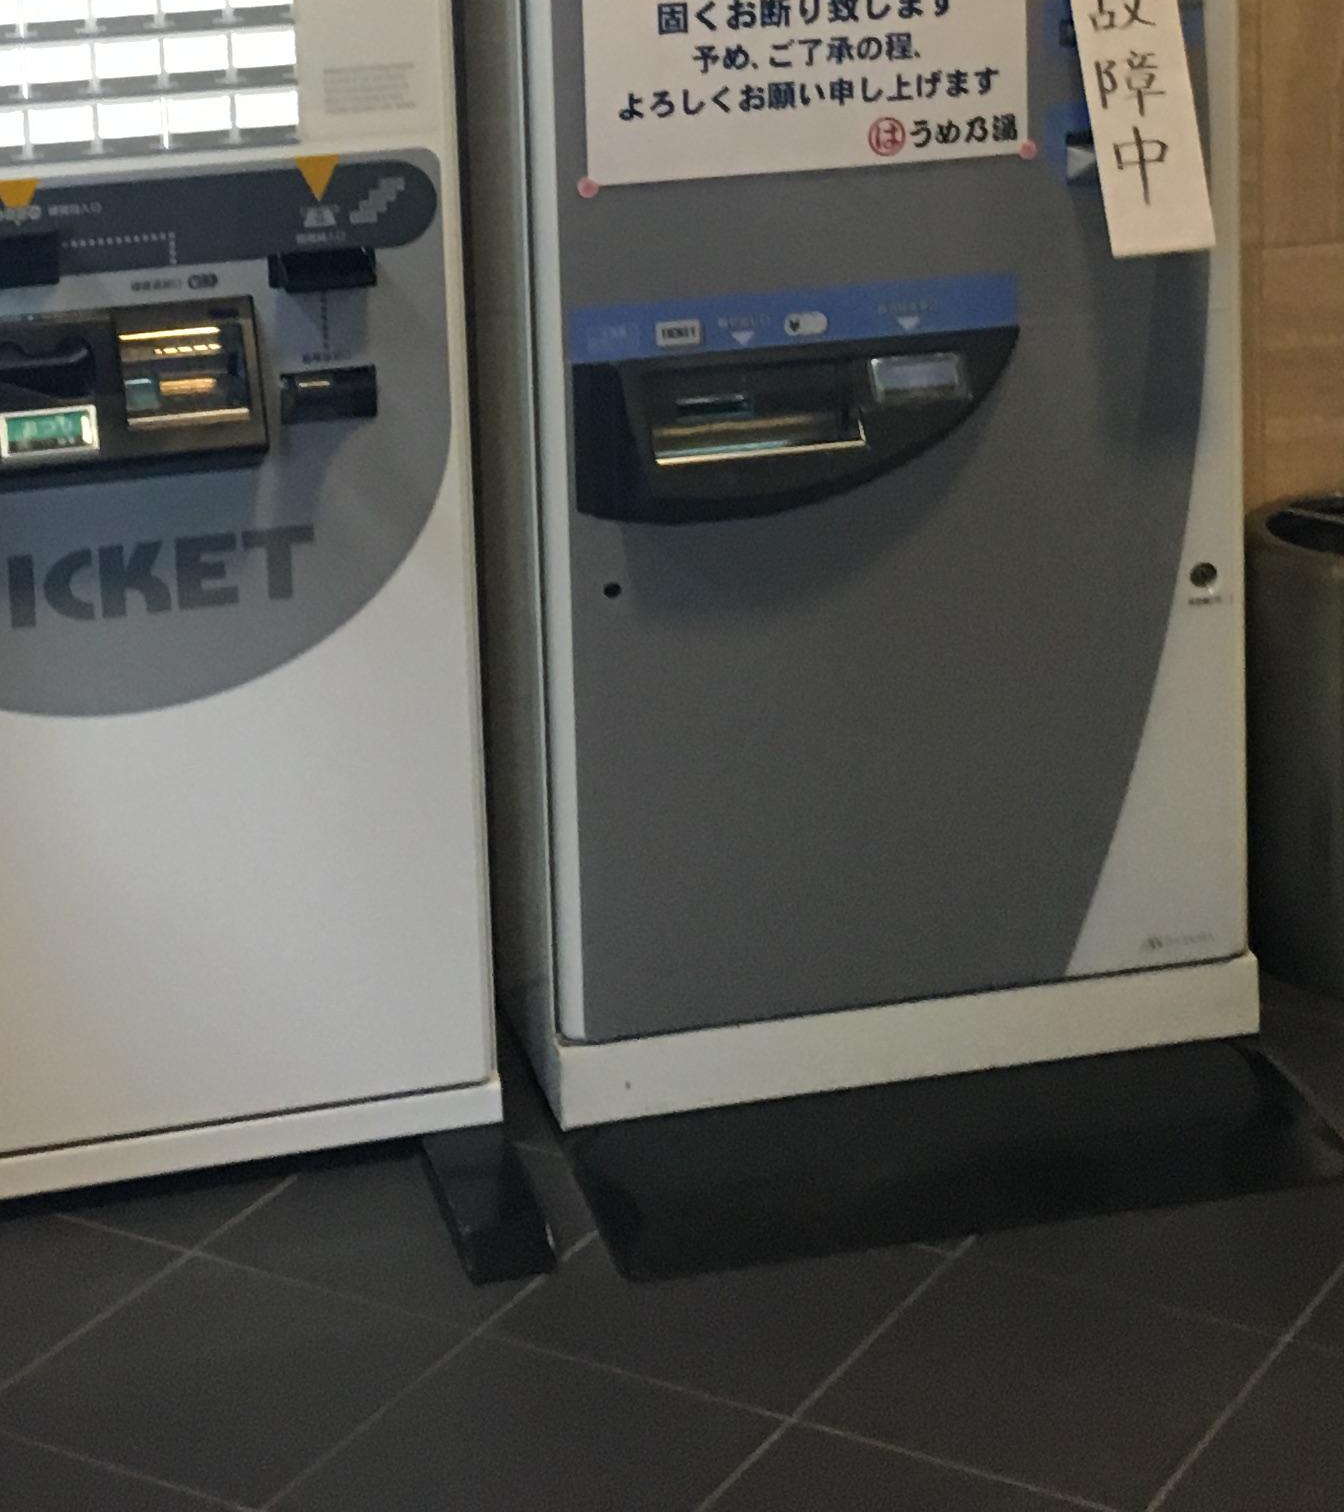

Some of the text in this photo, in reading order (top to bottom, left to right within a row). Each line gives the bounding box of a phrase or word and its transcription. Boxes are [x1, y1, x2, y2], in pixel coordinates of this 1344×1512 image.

[693, 33, 922, 74] 予め、ご了承の程、
[617, 68, 1000, 121] よろしくお願い申し上げます
